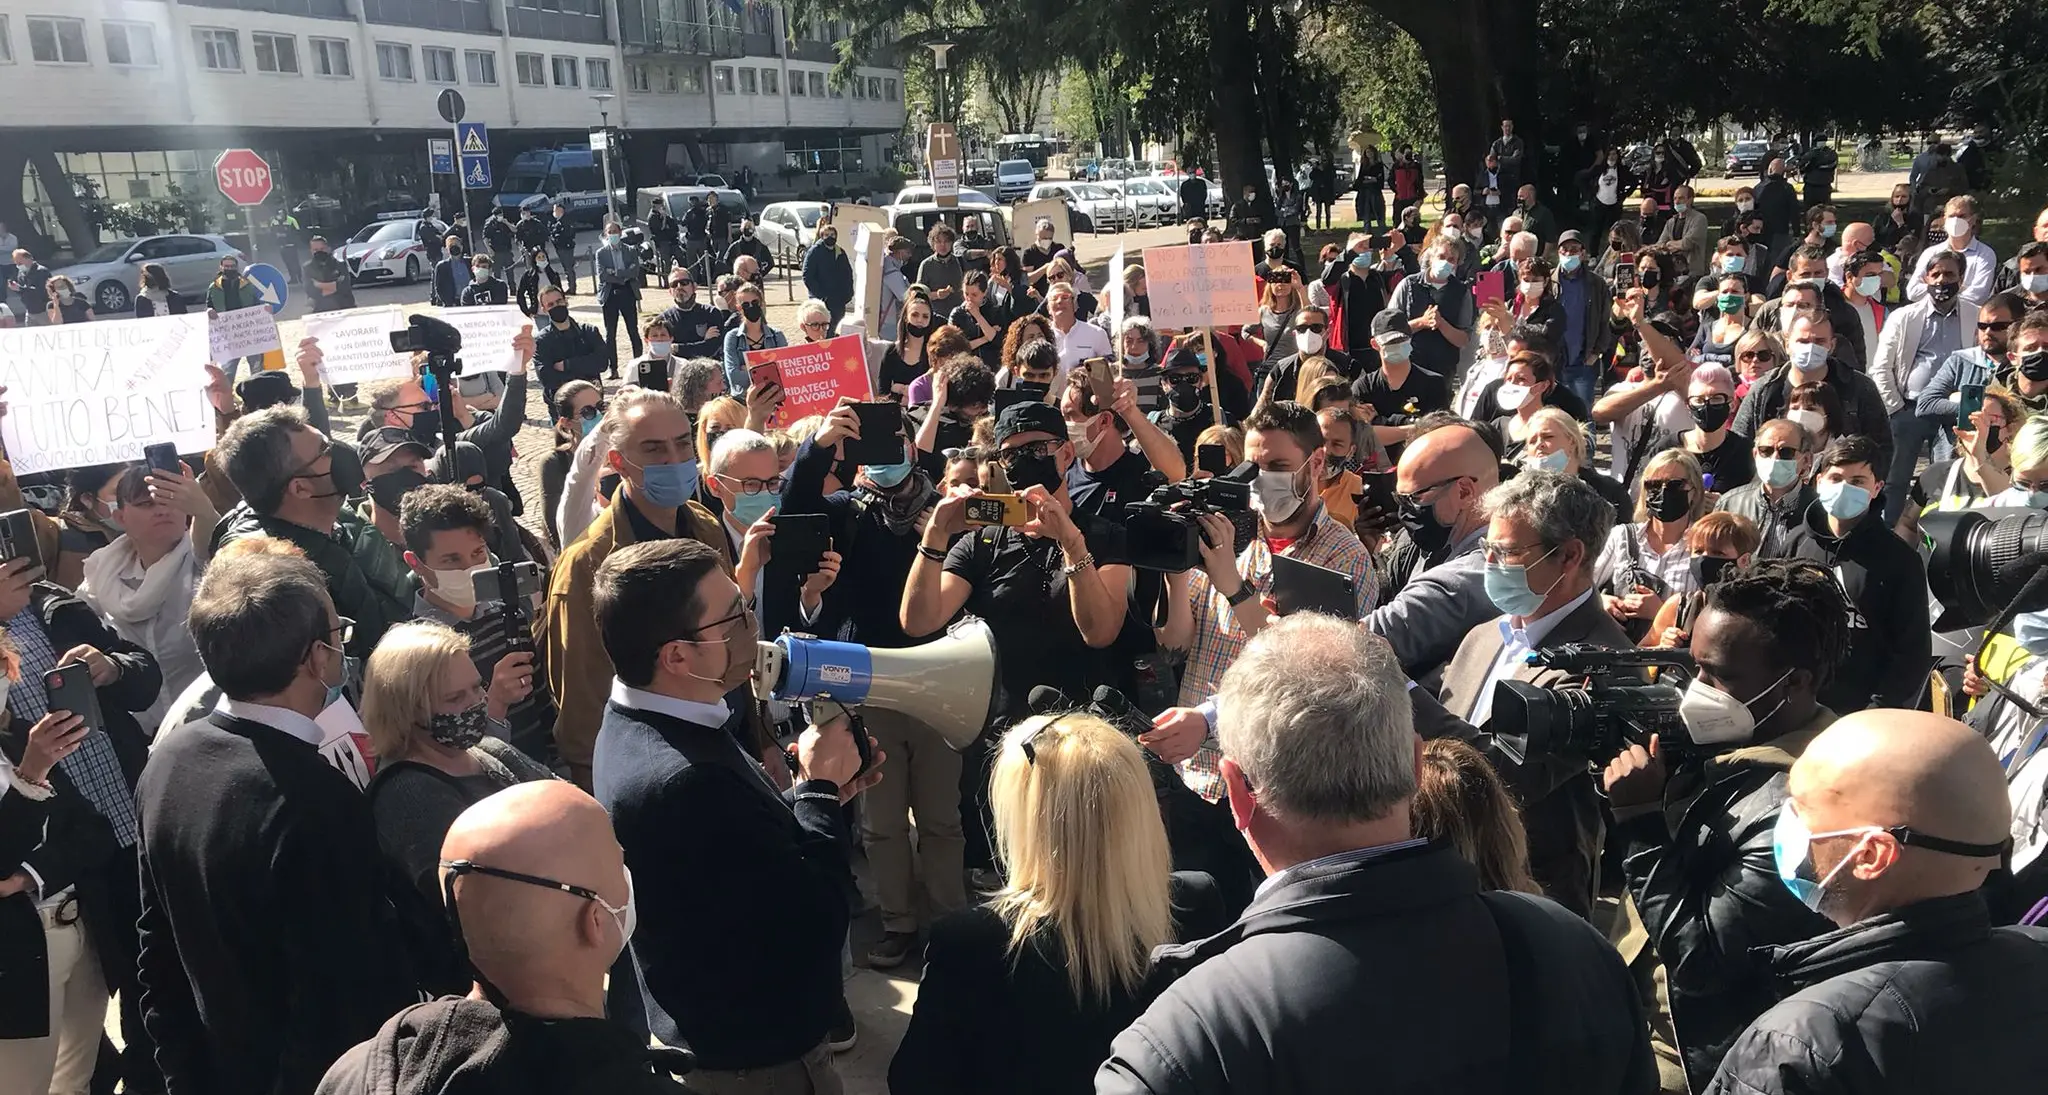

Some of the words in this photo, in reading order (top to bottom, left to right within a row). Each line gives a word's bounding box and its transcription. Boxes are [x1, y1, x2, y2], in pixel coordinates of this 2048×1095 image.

[220, 166, 268, 188] STOP
[573, 198, 599, 207] POLIZIA
[1156, 248, 1175, 263] NO
[34, 329, 88, 353] AVETE
[354, 339, 384, 349] DIRITTO
[326, 351, 370, 362] GARANTITO
[778, 353, 824, 369] TENETEVI
[825, 351, 835, 361] IL
[785, 362, 831, 377] RISTORO
[783, 381, 829, 397] RIDATECI
[831, 379, 840, 388] IL
[792, 389, 835, 405] LAVORO
[12, 398, 91, 454] TUTTO
[980, 500, 987, 510] TO
[823, 665, 850, 674] VONYX
